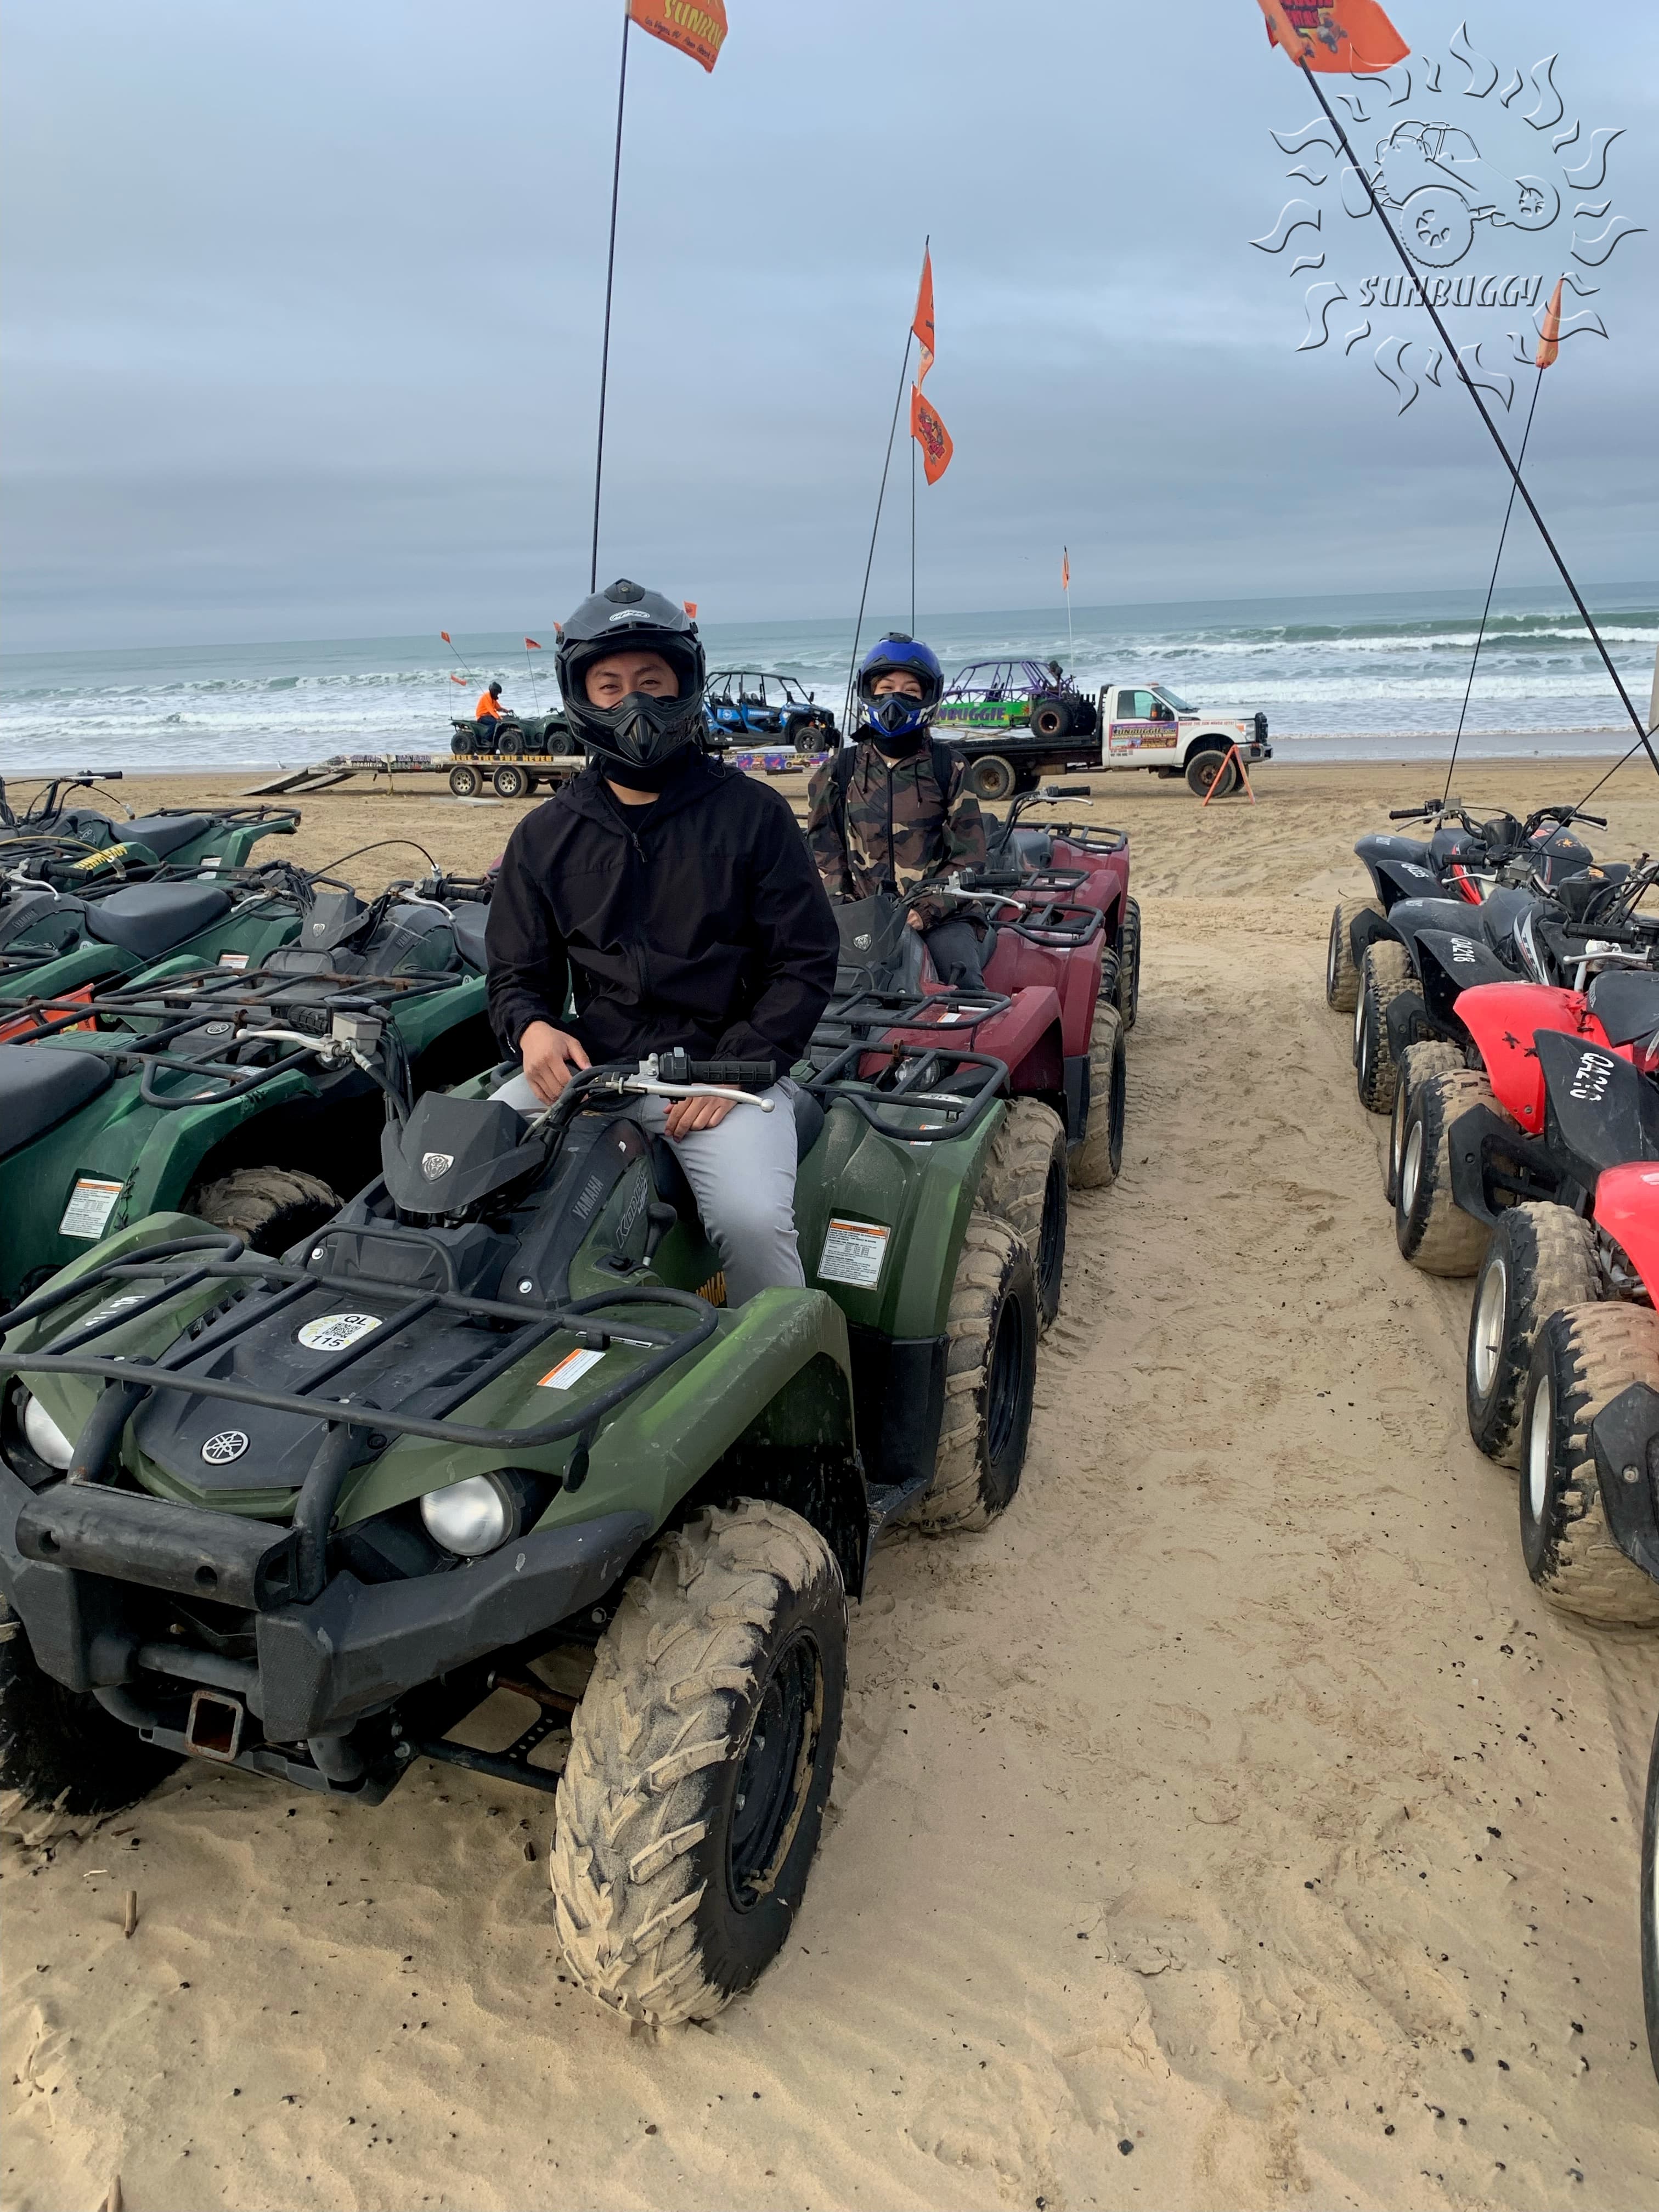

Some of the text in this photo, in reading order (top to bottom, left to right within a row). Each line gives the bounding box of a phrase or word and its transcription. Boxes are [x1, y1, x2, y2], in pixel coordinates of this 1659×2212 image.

[572, 1175, 604, 1220] YAMAHA
[344, 1316, 367, 1326] QL
[311, 1335, 345, 1347] 115
